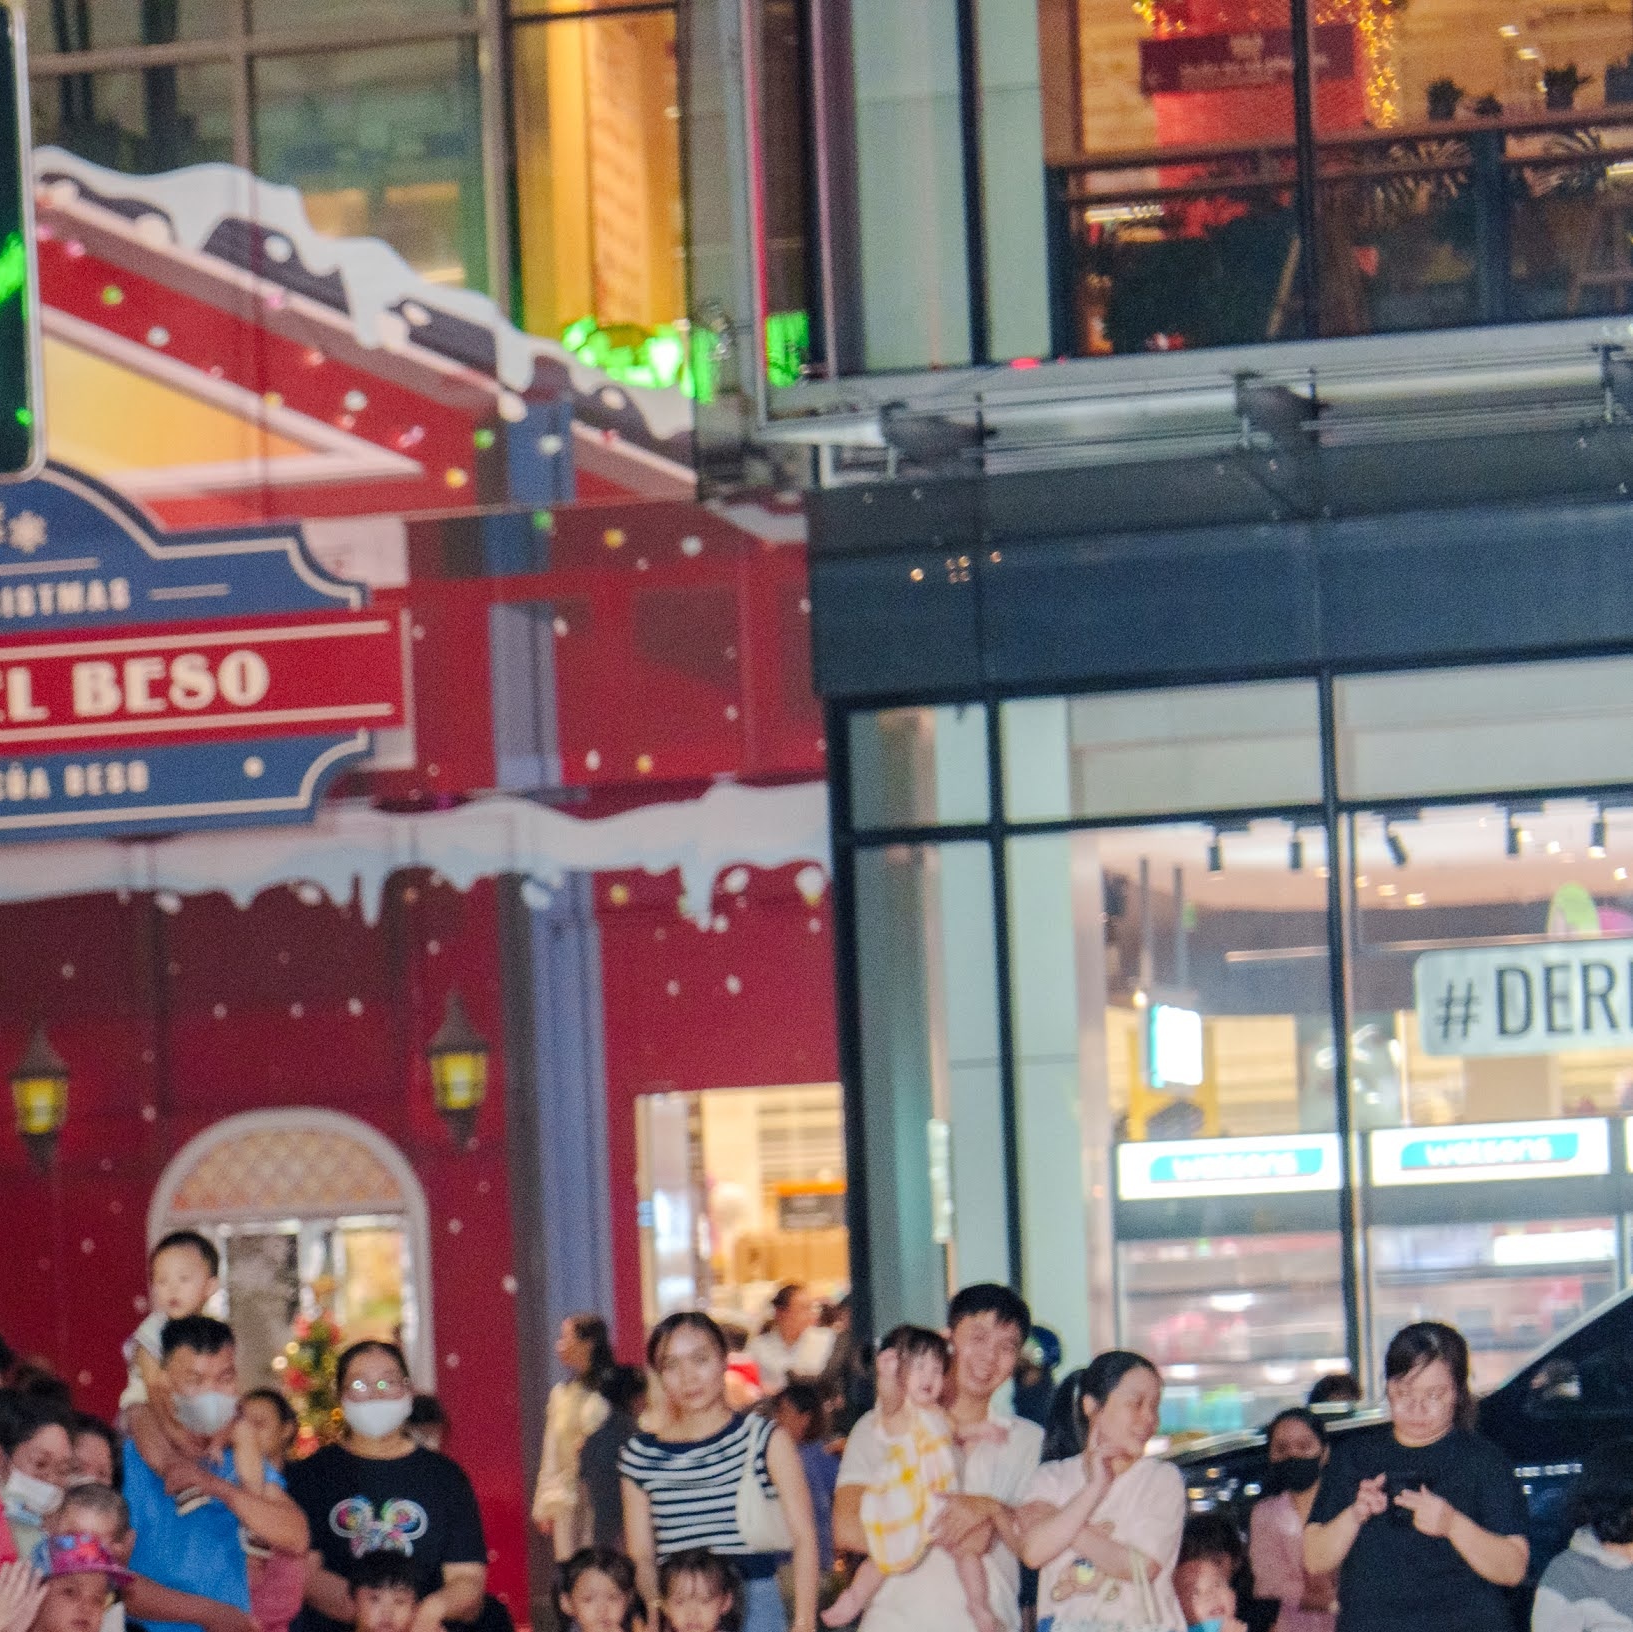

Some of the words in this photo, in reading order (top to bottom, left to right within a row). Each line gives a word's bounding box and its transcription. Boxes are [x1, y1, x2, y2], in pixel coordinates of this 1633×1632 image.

[72, 649, 270, 717] BESO
[64, 760, 149, 797] BESO
[1434, 961, 1633, 1041] #DER
